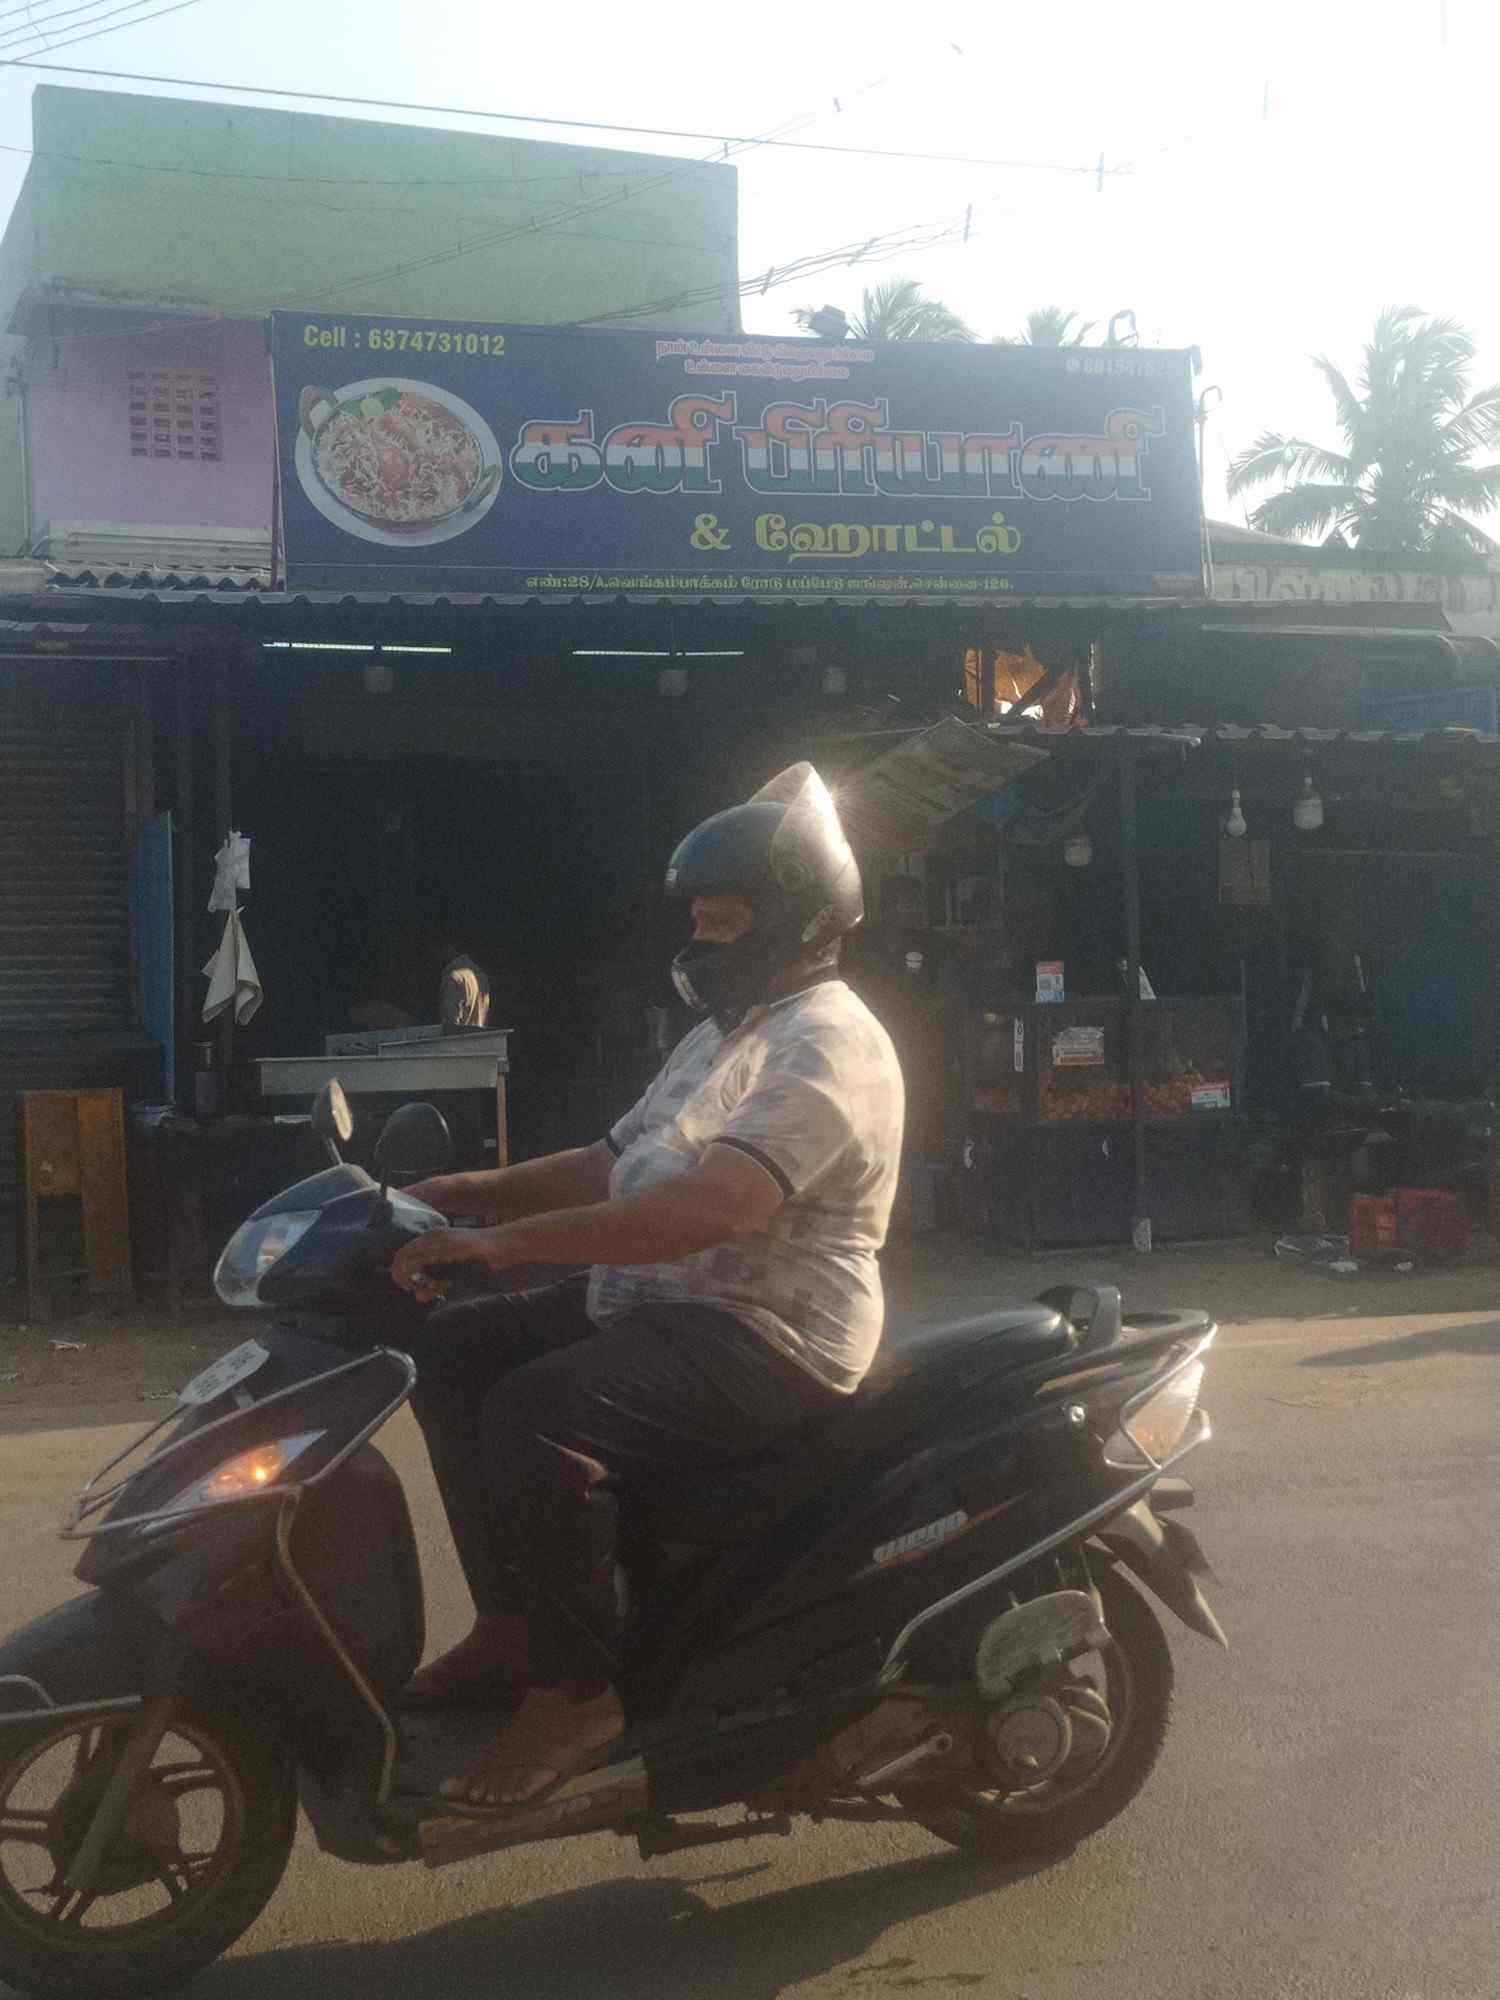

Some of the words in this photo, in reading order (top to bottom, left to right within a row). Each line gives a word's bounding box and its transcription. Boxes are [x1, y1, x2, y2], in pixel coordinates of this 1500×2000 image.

[303, 324, 346, 347] Cell
[368, 328, 505, 356] 6374731012
[509, 391, 737, 494] கனி
[733, 398, 1165, 501] பிரியாணி
[690, 513, 731, 551] &
[754, 512, 1022, 563] ஹோட்டல்
